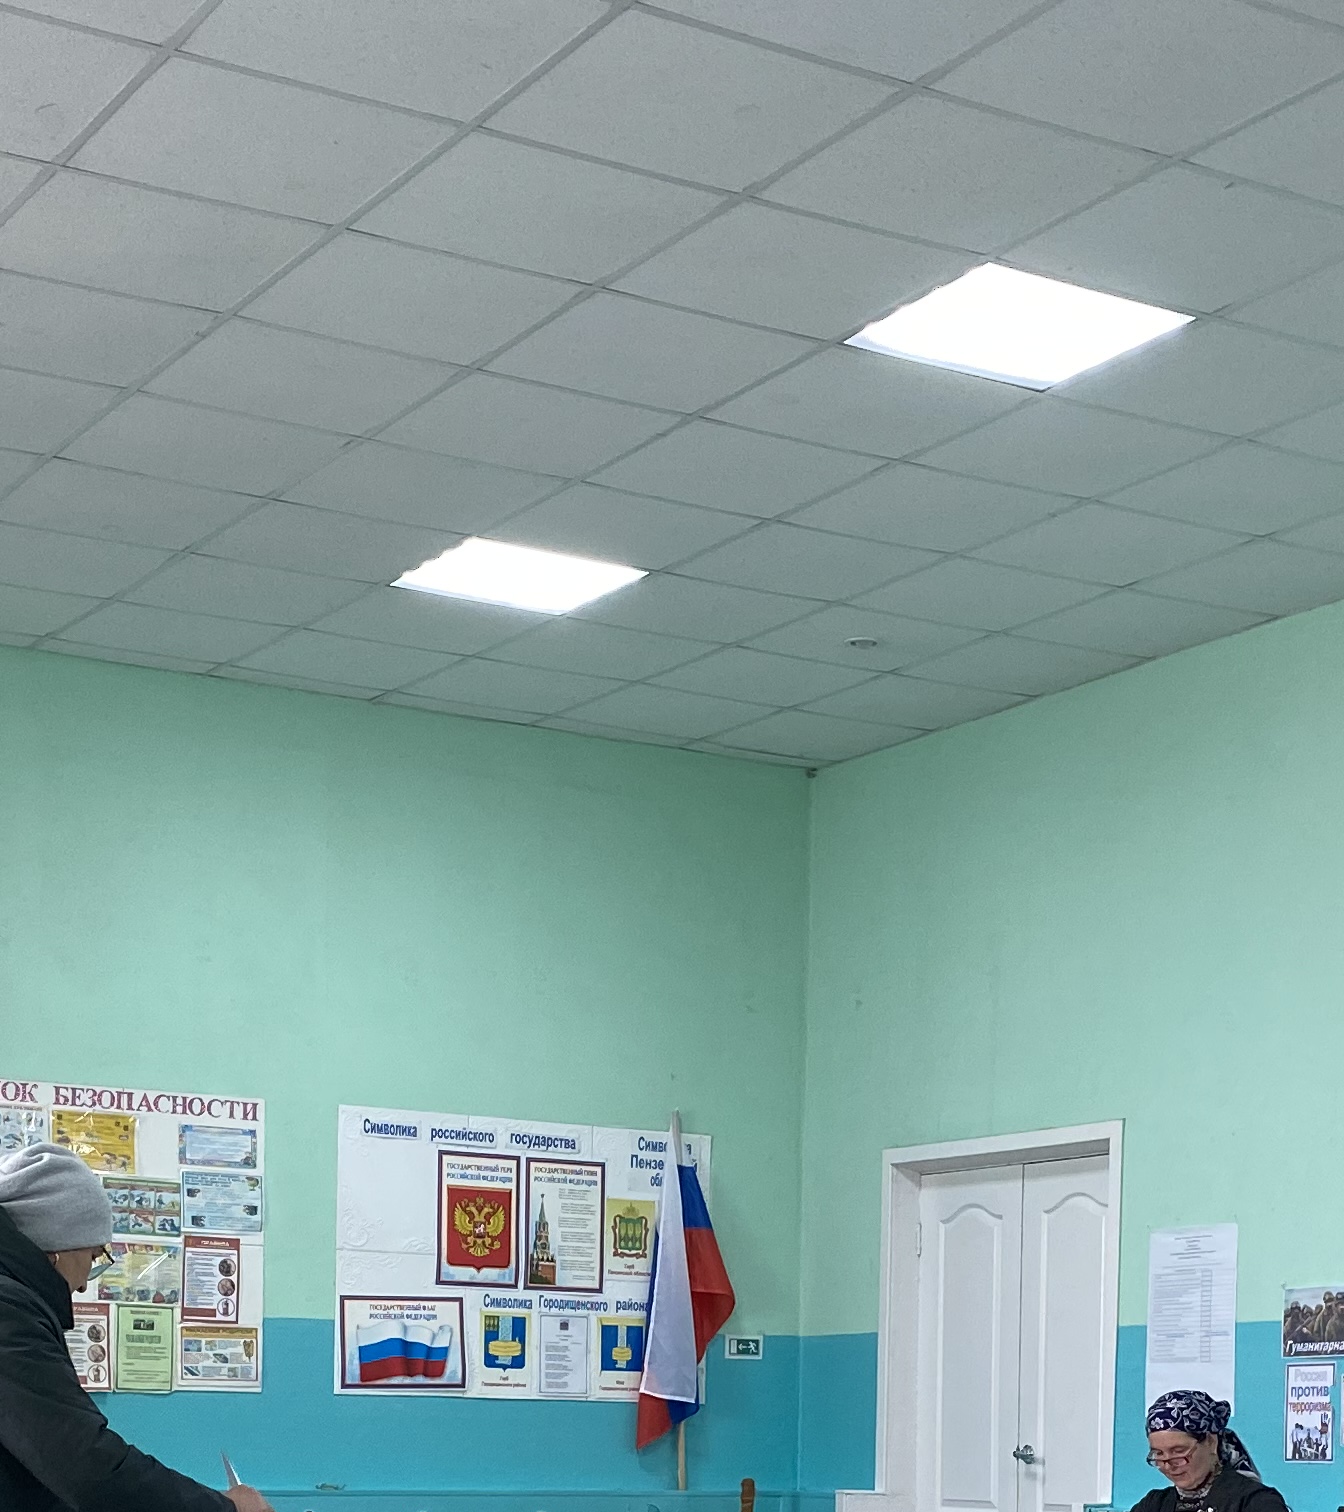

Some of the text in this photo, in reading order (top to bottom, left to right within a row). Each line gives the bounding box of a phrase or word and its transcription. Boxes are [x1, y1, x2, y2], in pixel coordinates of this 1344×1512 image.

[52, 1085, 260, 1122] БЕЗОПАСНОСТИ
[363, 1118, 576, 1150] Символика российского государства
[483, 1293, 533, 1309] Символика
[539, 1295, 608, 1312] Городищенского
[1291, 1386, 1329, 1400] против
